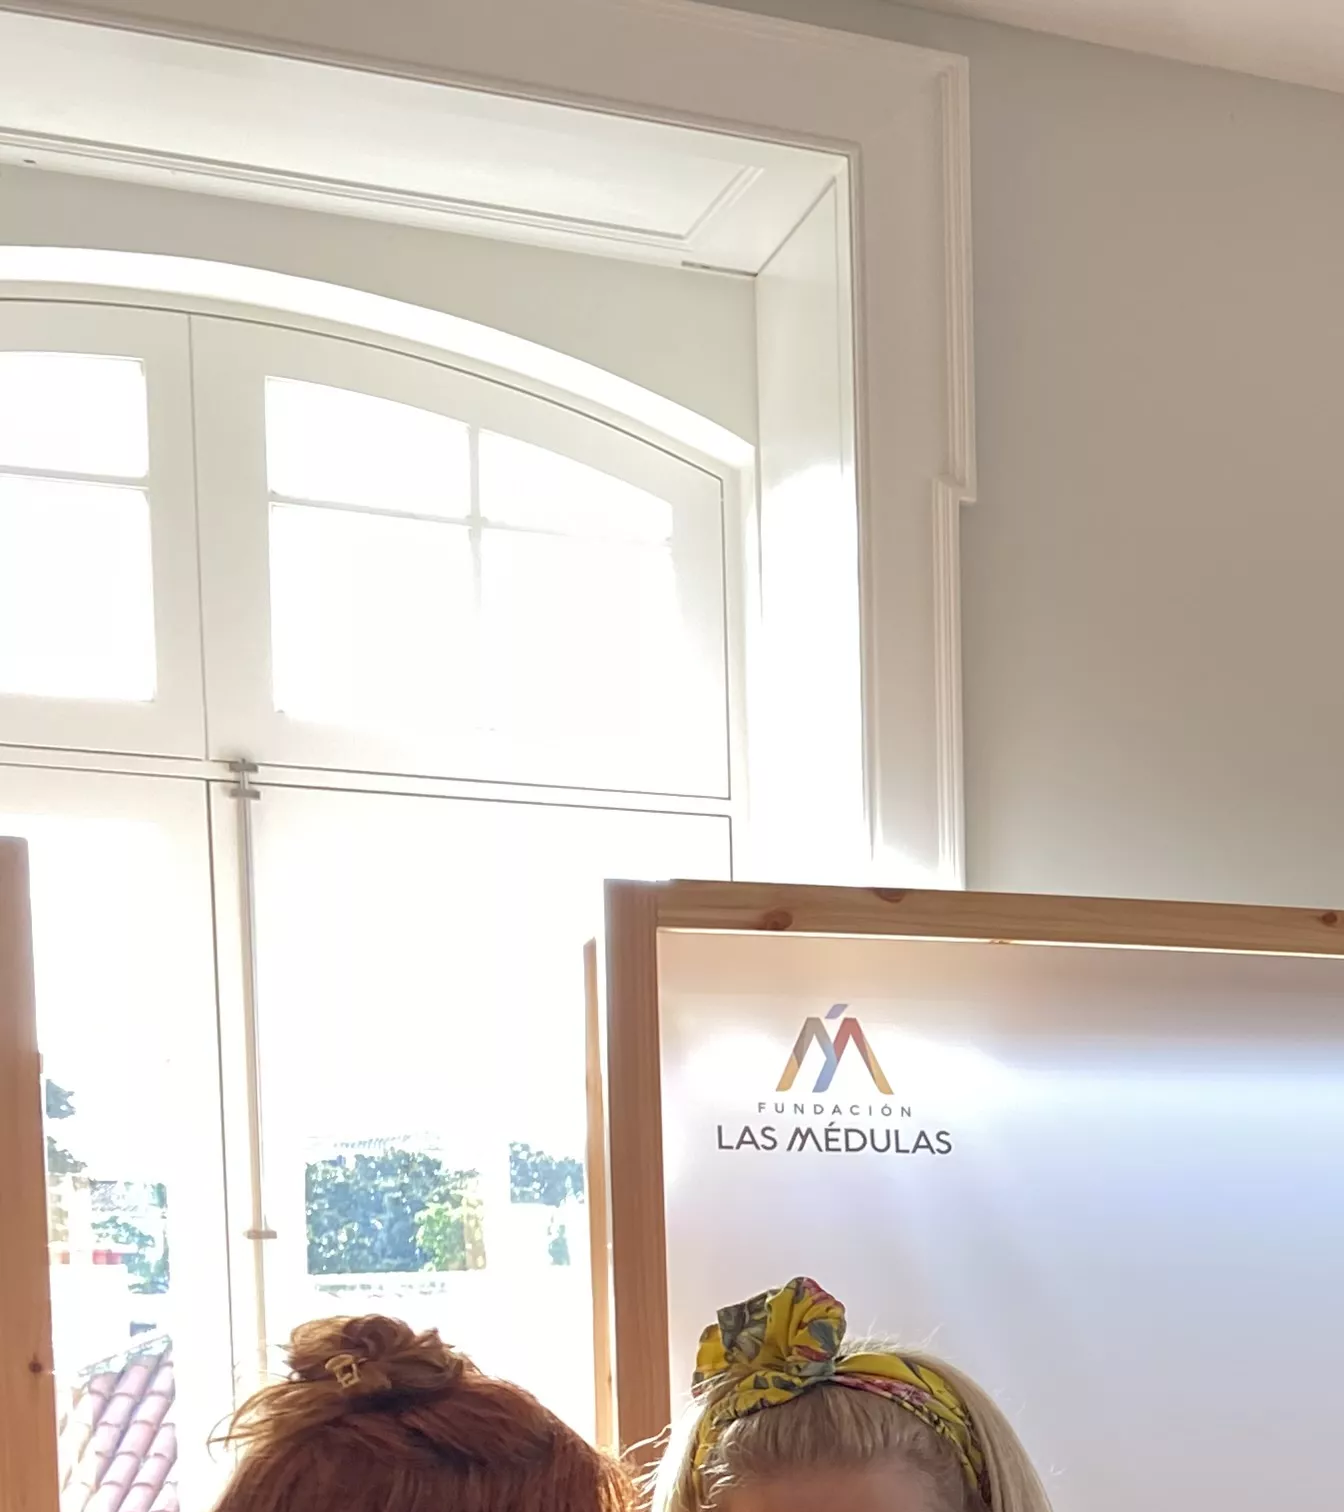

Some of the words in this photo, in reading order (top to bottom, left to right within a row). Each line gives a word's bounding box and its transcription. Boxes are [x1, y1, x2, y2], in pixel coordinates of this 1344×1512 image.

[757, 1102, 913, 1118] FUNDACIÓN
[716, 1124, 777, 1151] LAS
[786, 1121, 953, 1155] MÉDULAS
